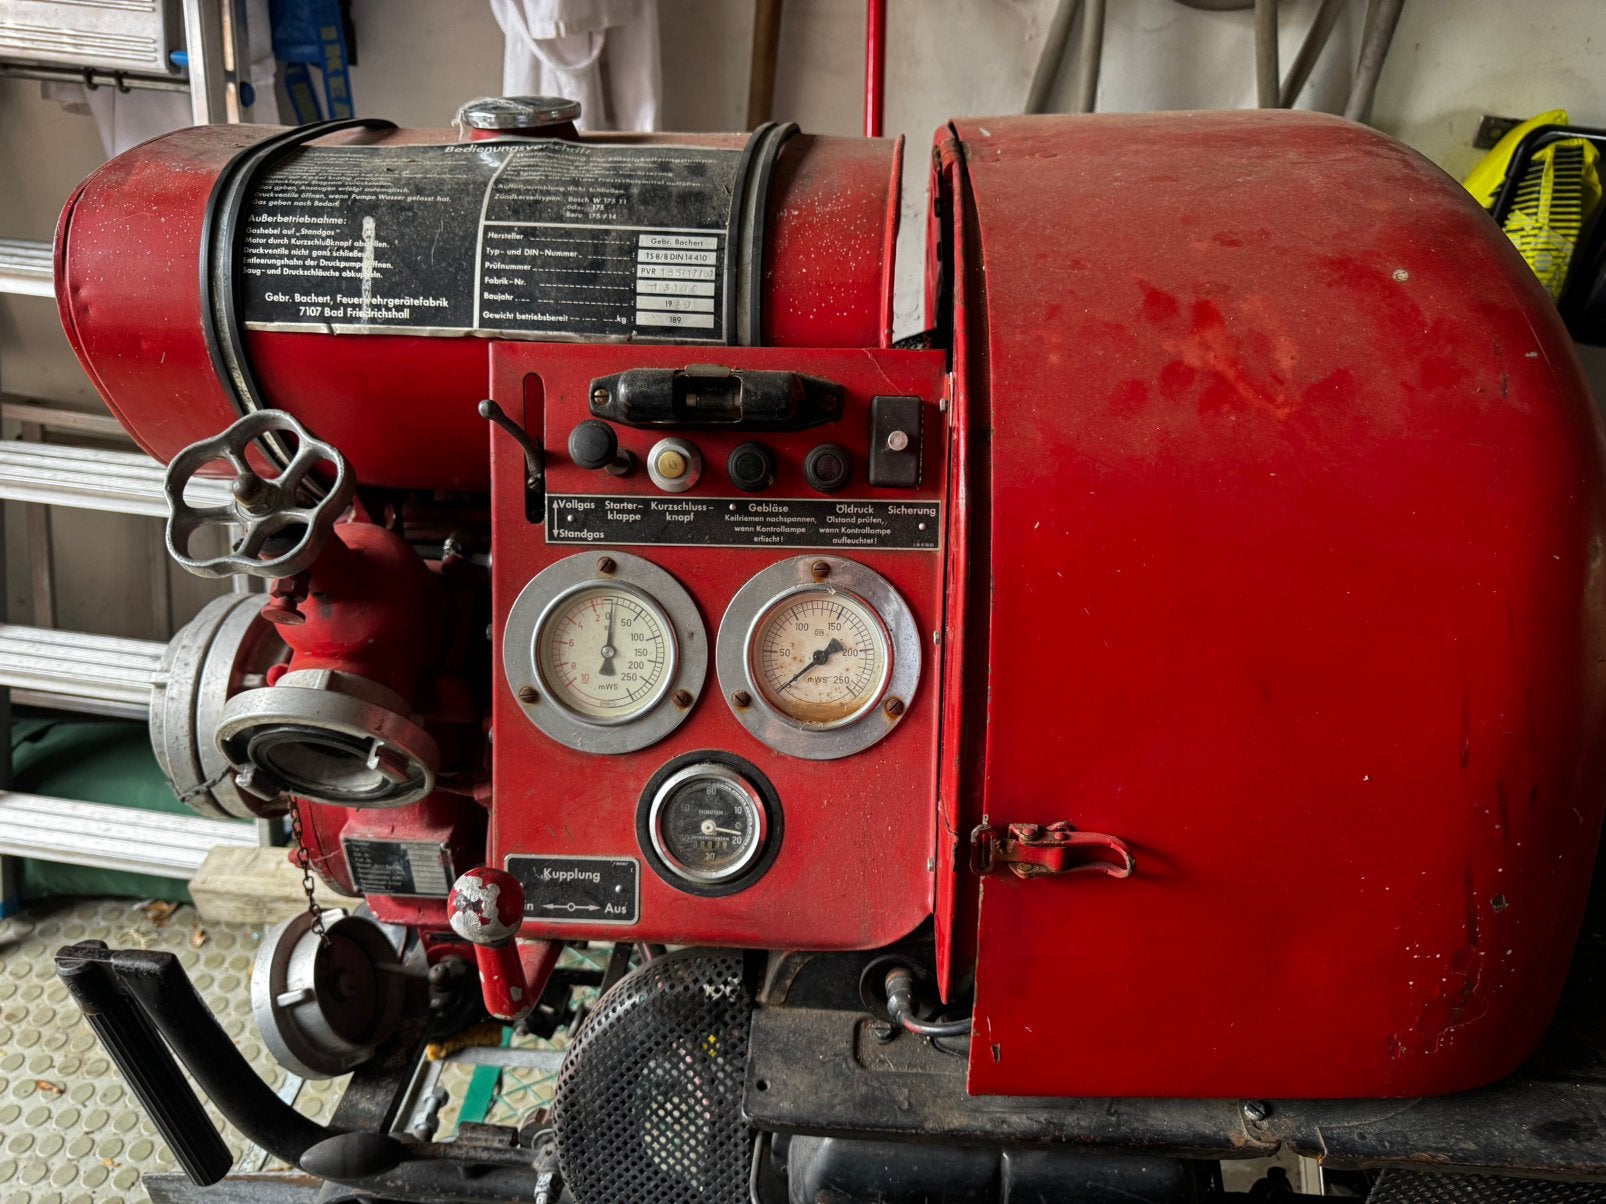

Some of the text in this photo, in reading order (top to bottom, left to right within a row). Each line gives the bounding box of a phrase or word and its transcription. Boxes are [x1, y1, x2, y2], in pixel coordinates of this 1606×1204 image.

[248, 214, 347, 224] Außerbetriebnahme:
[246, 227, 280, 235] Gashebel
[488, 232, 524, 240] Hersteller
[291, 238, 352, 247] Kurzschlußknopf
[651, 238, 703, 247] Gebr. Bachert
[244, 246, 289, 255] Druckventile
[291, 248, 309, 256] nicht
[333, 250, 366, 258] schließe
[486, 248, 578, 257] Typ- und DIN-Nummer
[243, 257, 303, 266] Entleerungshahn
[305, 258, 318, 266] der
[694, 254, 708, 262] 410
[485, 262, 531, 270] Prüfnummer
[267, 267, 281, 275] und
[283, 268, 340, 277] Druckschläuche
[484, 276, 526, 286] Fabrik-Nr.
[265, 292, 292, 302] Gebr.
[295, 293, 334, 305] Bachert,
[484, 292, 514, 301] Baujahr
[299, 307, 410, 319] 7107 Bad Friedrichshall
[482, 311, 627, 325] Gewicht betriebsbereit kg
[670, 316, 682, 324] 189
[559, 500, 596, 511] Vollgas
[605, 501, 643, 510] Starter-
[748, 503, 789, 513] Gebläse
[836, 504, 874, 514] Öldruck
[888, 505, 936, 517] Sicherung
[607, 510, 642, 522] klappe
[666, 512, 694, 523] knopf
[724, 514, 817, 524] Keilriemen nachspannen,
[826, 516, 884, 525] Ölstand prüfen,
[756, 525, 806, 534] Kontrollampe
[841, 527, 892, 536] Kontrollampe
[559, 529, 604, 541] Standgas
[621, 619, 632, 627] 50
[795, 623, 809, 631] 100
[828, 622, 842, 631] 150
[631, 633, 644, 642] 100
[634, 649, 648, 657] 150
[780, 649, 790, 657] 50
[843, 649, 858, 657] 200
[572, 662, 576, 670] 8
[628, 661, 644, 670] 200
[581, 673, 590, 683] 10
[621, 673, 637, 681] 250
[834, 676, 850, 684] 250
[735, 806, 742, 814] 10
[732, 836, 742, 844] 20
[543, 868, 600, 883] Kupplung
[525, 900, 627, 914] in Aus
